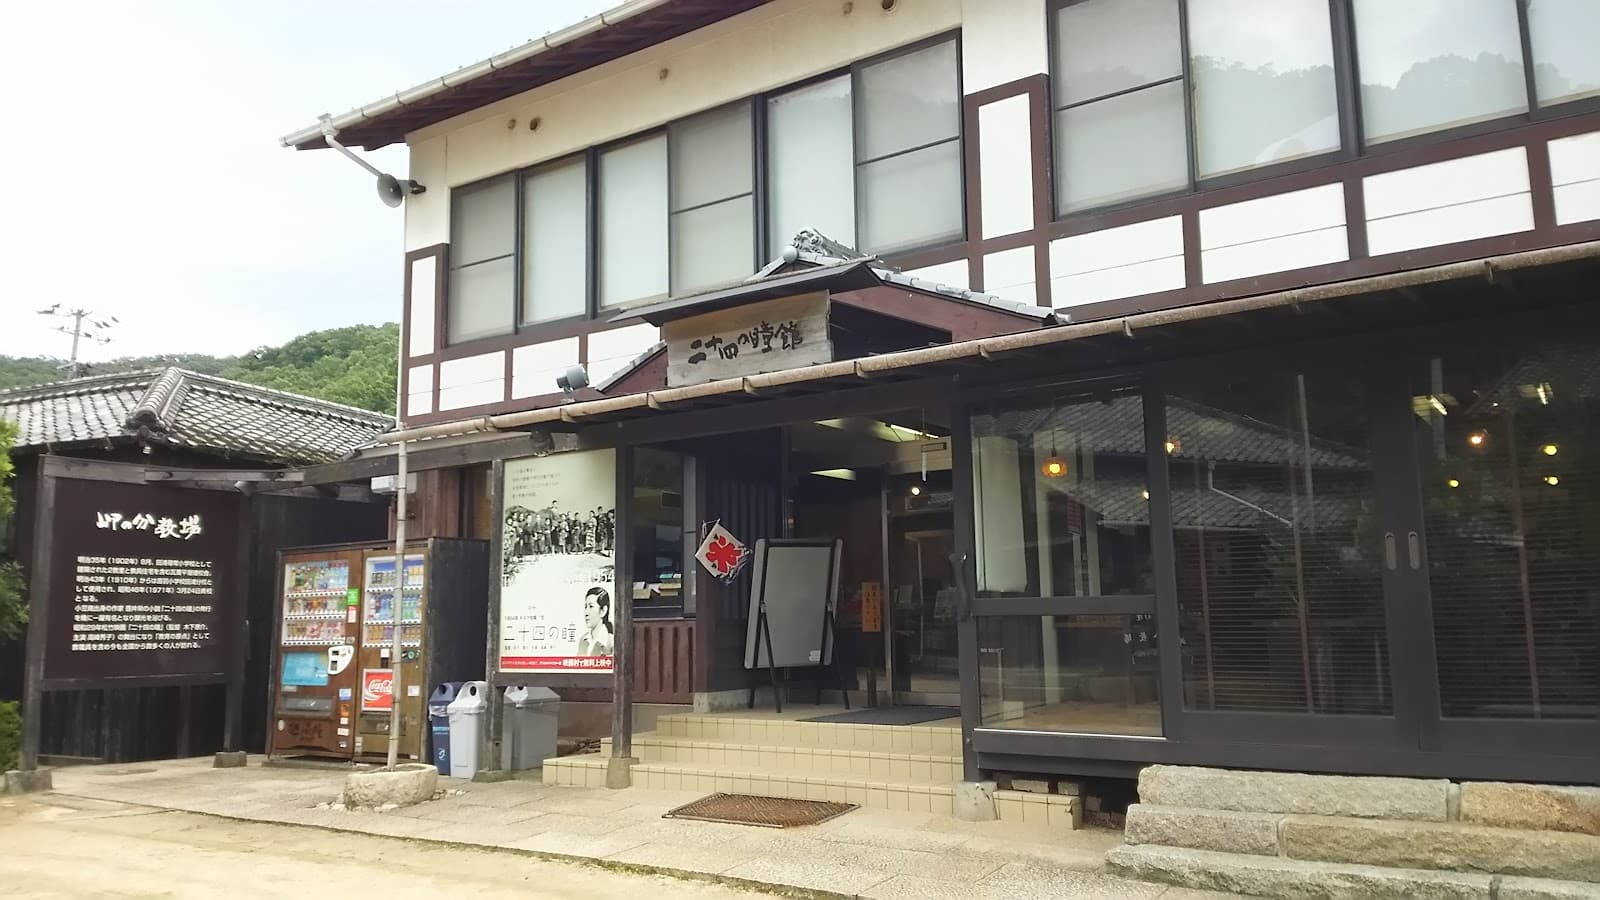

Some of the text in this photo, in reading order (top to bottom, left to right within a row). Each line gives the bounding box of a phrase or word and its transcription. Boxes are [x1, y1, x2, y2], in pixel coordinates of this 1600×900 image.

[688, 321, 803, 364] 二十四の瞳館
[96, 511, 202, 539] 岬の分教場
[503, 623, 577, 643] 二十四の瞳
